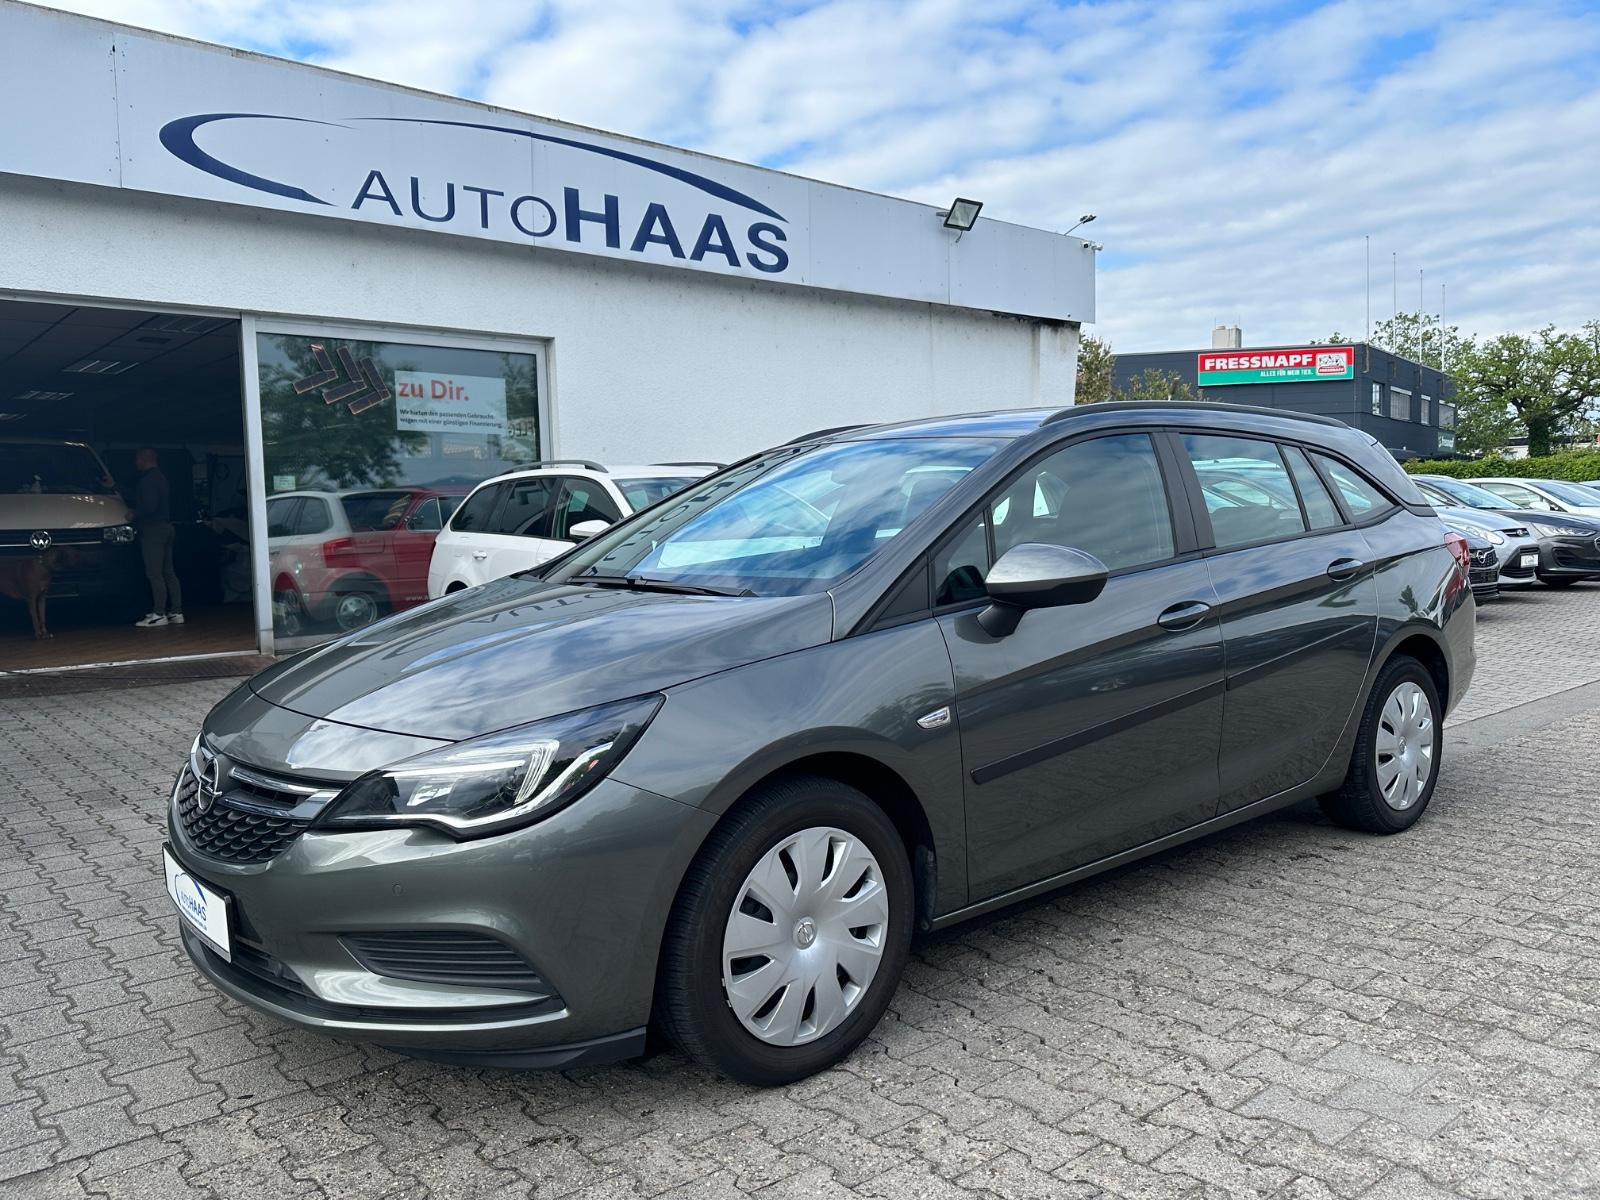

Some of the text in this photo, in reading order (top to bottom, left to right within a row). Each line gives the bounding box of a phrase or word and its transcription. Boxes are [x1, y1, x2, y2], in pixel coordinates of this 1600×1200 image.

[1204, 354, 1312, 370] FRESSNAPF
[398, 380, 469, 401] zu Dir.
